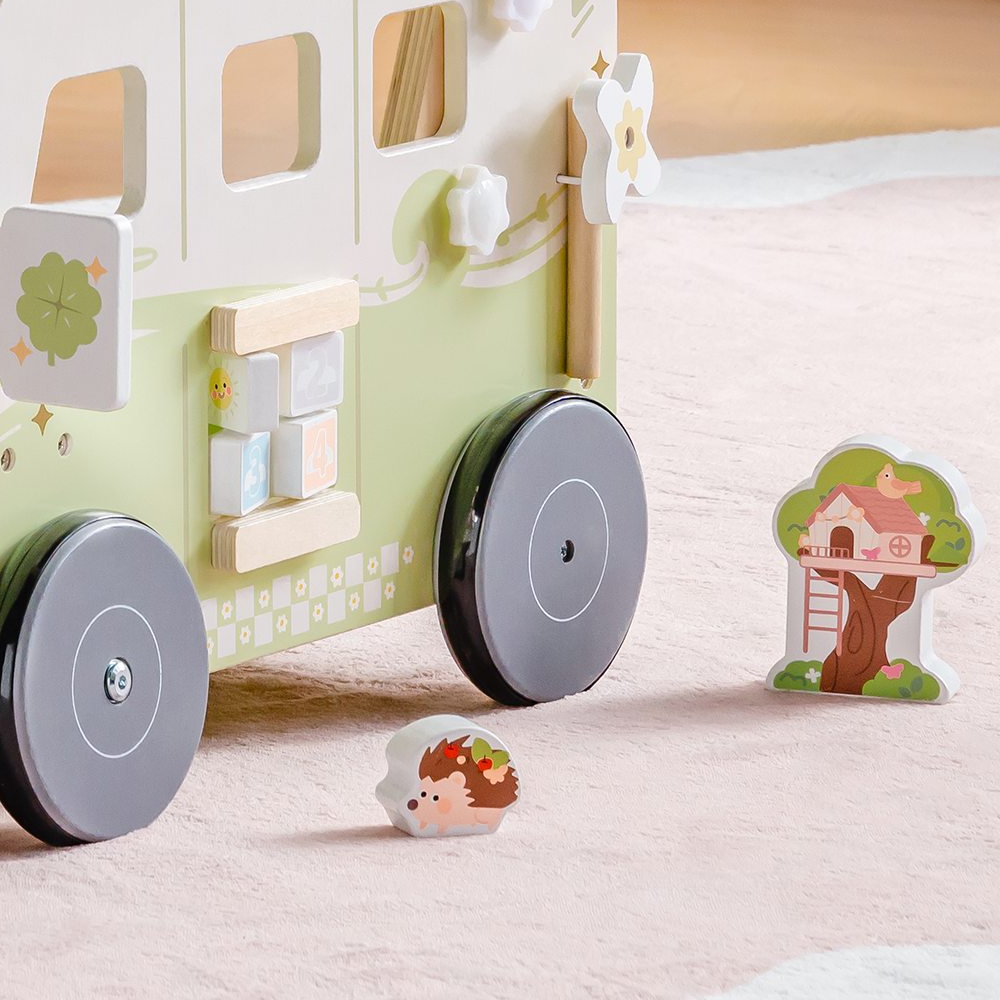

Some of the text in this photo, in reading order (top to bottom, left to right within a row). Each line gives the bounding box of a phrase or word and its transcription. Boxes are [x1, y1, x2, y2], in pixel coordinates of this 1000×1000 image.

[304, 347, 328, 400] 2
[248, 445, 262, 498] 3
[311, 427, 328, 479] 4
